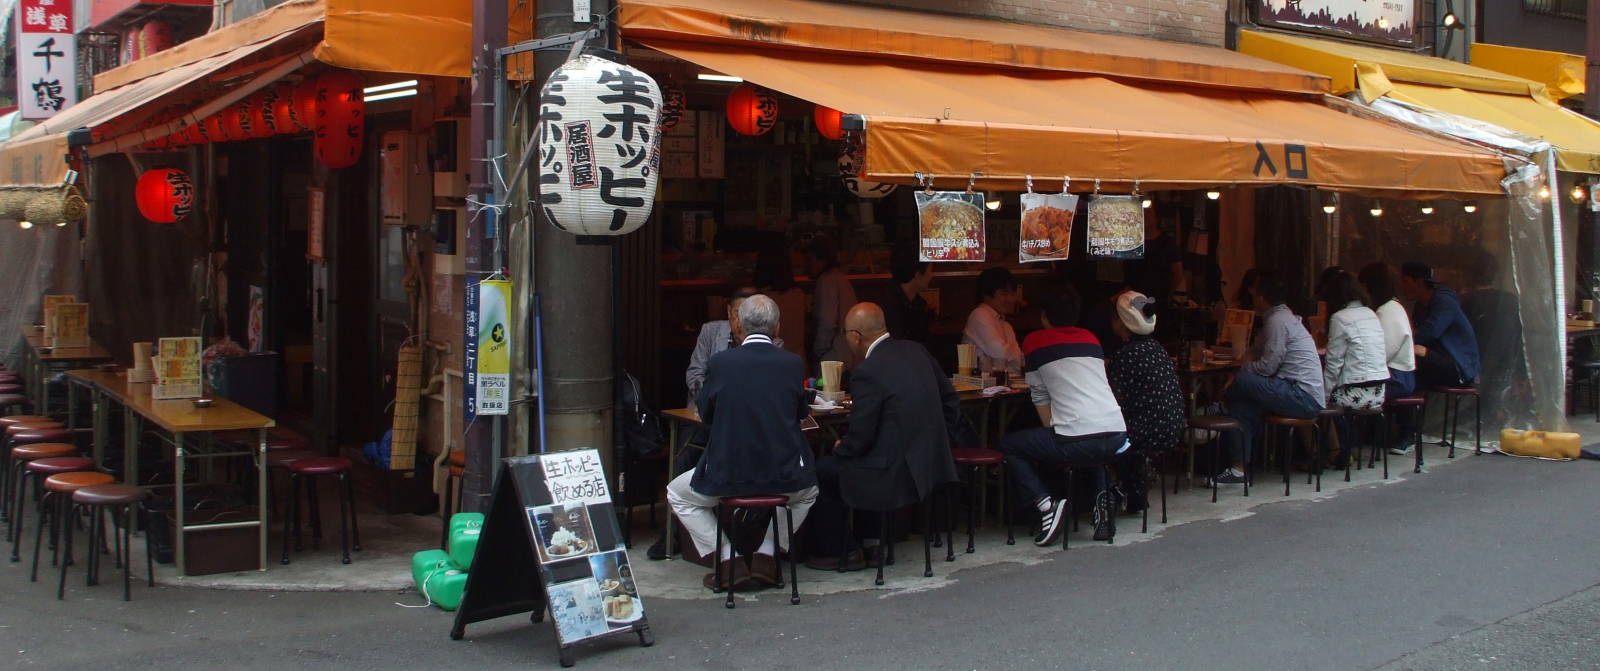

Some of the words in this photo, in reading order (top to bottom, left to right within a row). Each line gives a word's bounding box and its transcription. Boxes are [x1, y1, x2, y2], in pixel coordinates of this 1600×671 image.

[32, 37, 65, 111] 千鶴
[567, 124, 594, 187] 居酒屋
[597, 69, 654, 231] 生ホッピー
[1253, 140, 1308, 179] 入口
[547, 455, 600, 478] 生ホッピー
[552, 475, 606, 503] 飲める店
